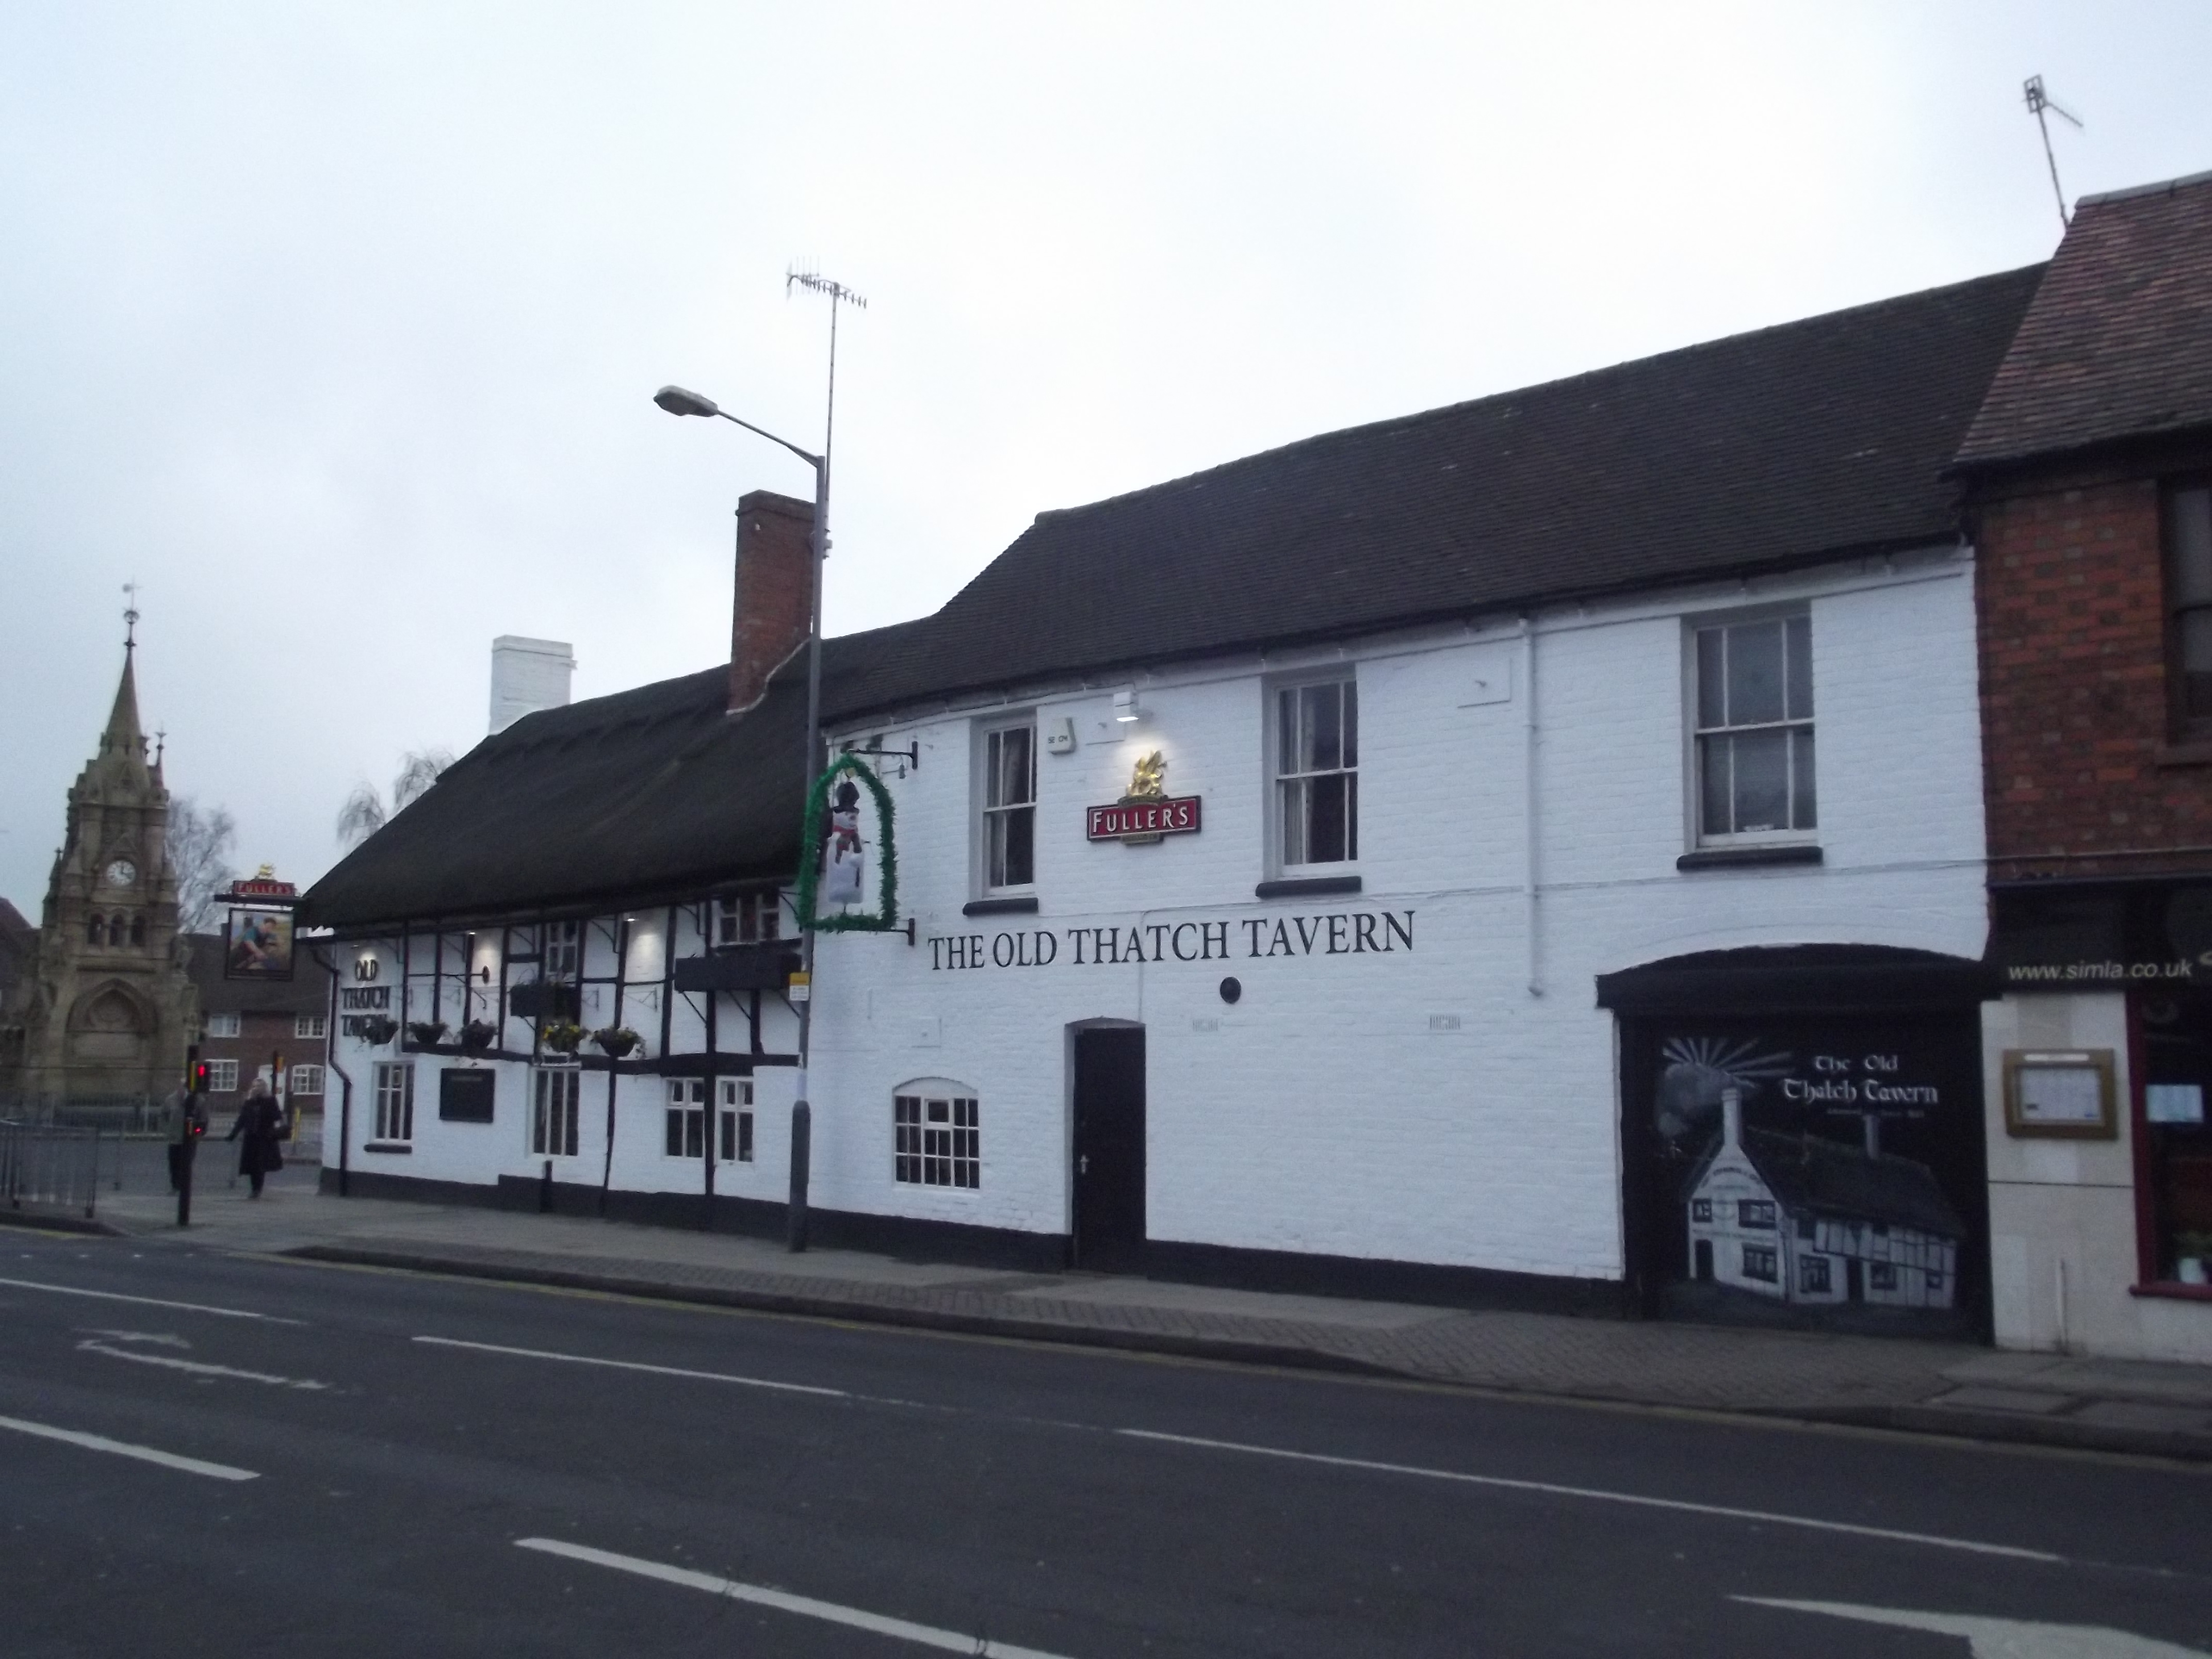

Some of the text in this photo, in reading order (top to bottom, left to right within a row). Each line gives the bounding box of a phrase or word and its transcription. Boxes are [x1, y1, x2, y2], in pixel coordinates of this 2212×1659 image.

[1093, 803, 1189, 833] FULLER'S
[928, 910, 1416, 970] THE OLD THATCH TAVERN
[355, 959, 378, 981] OLD
[2008, 958, 2193, 979] www.simla.co.uk
[341, 986, 391, 1009] THATCH
[1864, 1054, 1898, 1070] Old
[1783, 1078, 1939, 1104] Thatch Tavern
